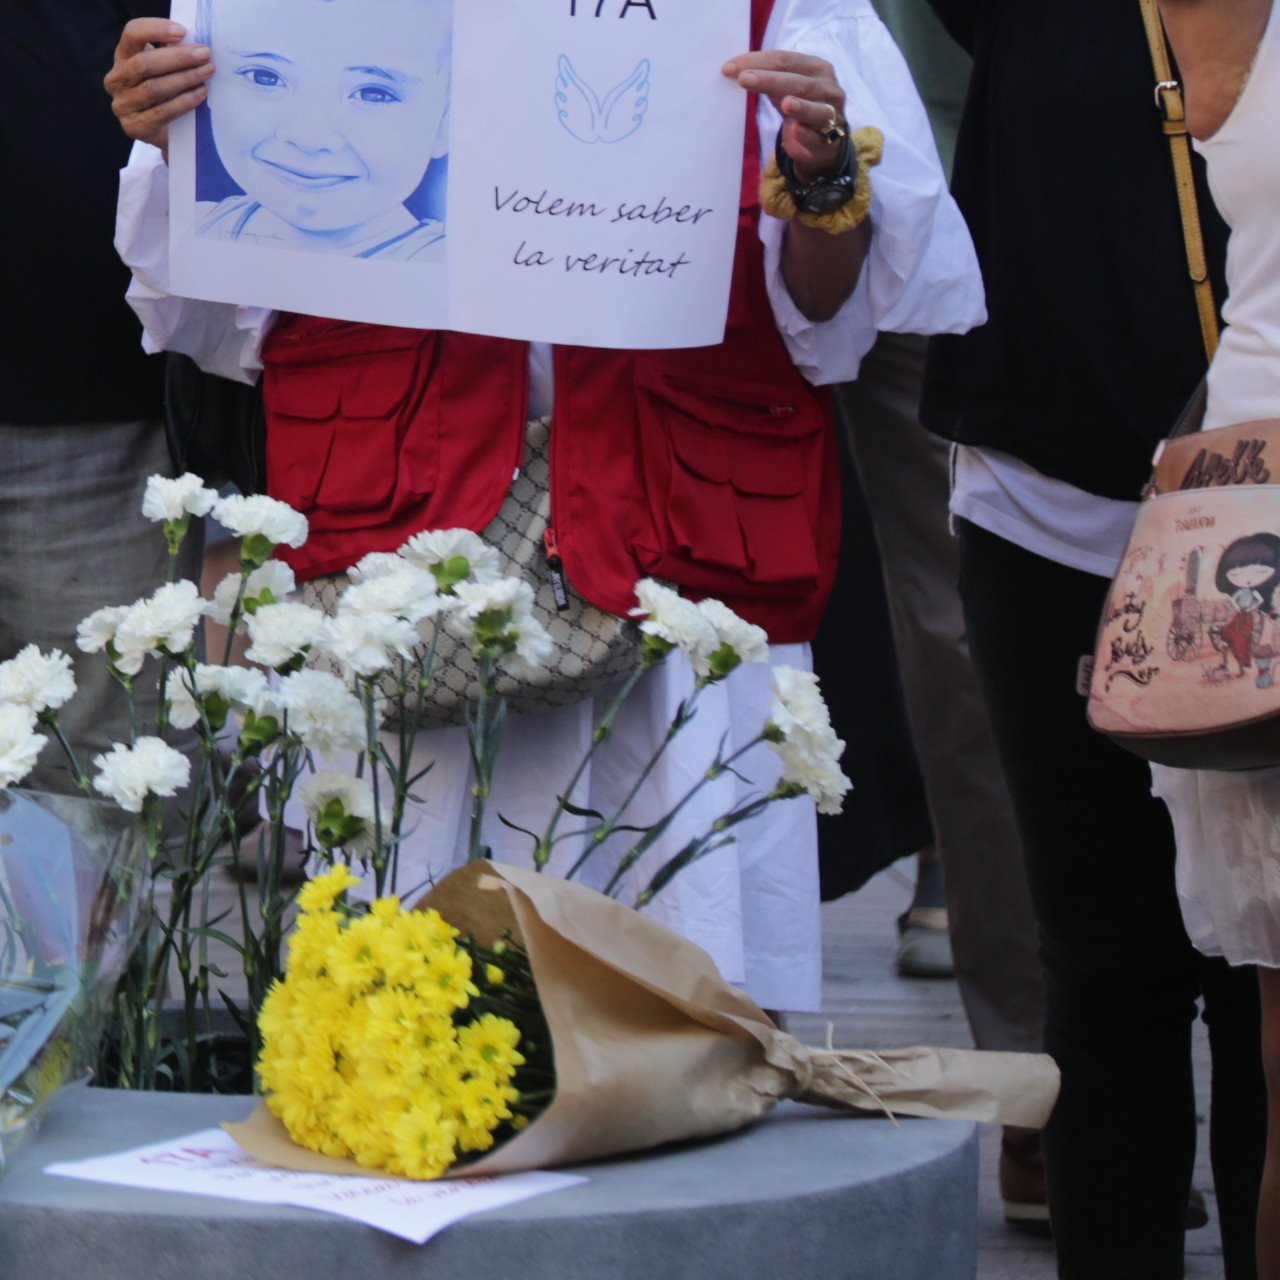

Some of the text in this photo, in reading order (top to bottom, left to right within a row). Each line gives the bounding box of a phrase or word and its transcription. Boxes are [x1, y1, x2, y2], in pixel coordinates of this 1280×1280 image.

[493, 185, 714, 225] Volem saber
[512, 240, 691, 279] la veritat
